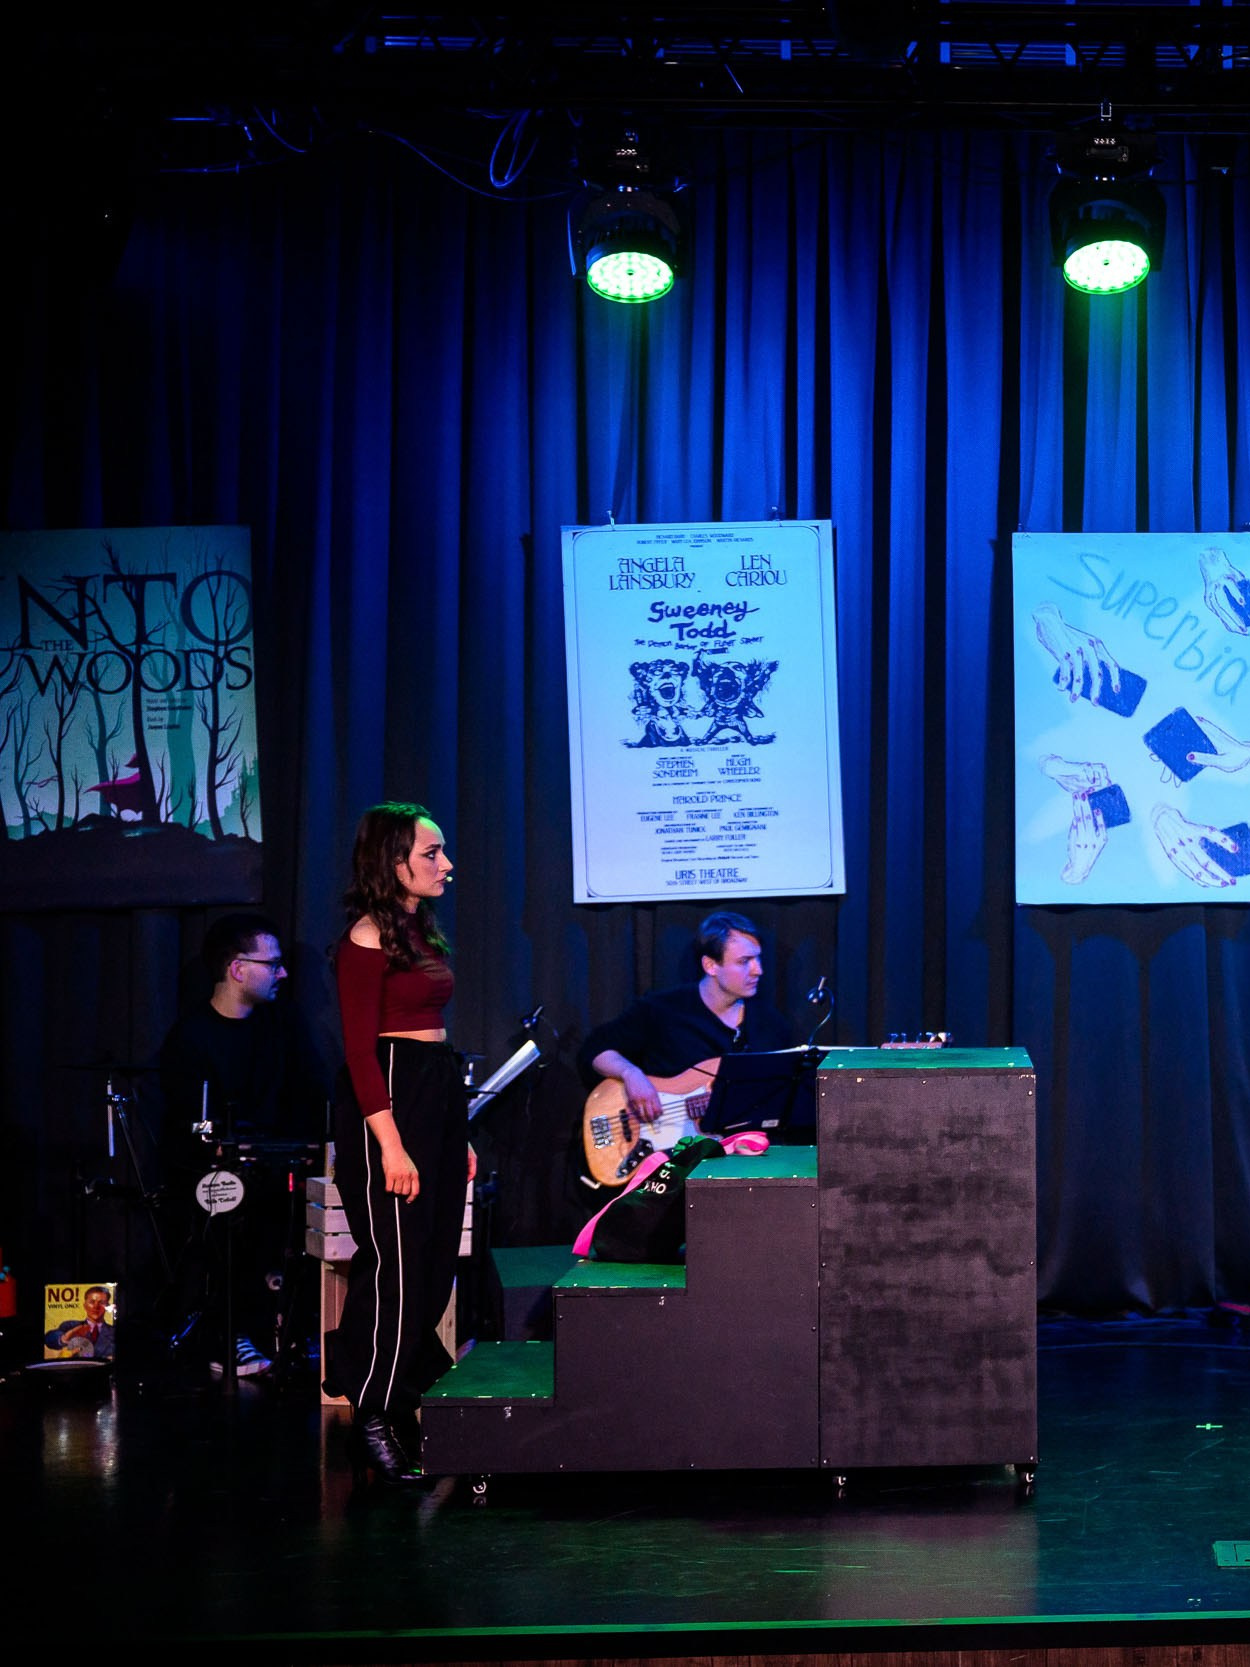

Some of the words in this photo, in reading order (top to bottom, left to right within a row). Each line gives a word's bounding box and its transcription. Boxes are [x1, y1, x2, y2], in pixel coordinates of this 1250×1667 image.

[617, 556, 685, 574] ANGELA
[740, 554, 772, 571] LEN
[609, 572, 696, 591] LANSBURY
[725, 569, 788, 588] CARIOU
[0, 570, 253, 650] NTO
[648, 600, 760, 622] Sweeney
[669, 619, 736, 641] Todd
[41, 640, 74, 651] THE
[24, 646, 253, 697] WOODS
[655, 760, 695, 769] STEPHEN
[726, 757, 751, 766] HUGH
[652, 769, 698, 779] SONDHEIM
[718, 766, 760, 776] WHEELER
[672, 795, 708, 804] HAROLD
[710, 793, 742, 803] PRINCE
[675, 869, 697, 880] URIS
[699, 867, 739, 879] THEATRE
[48, 1288, 79, 1303] NO!
